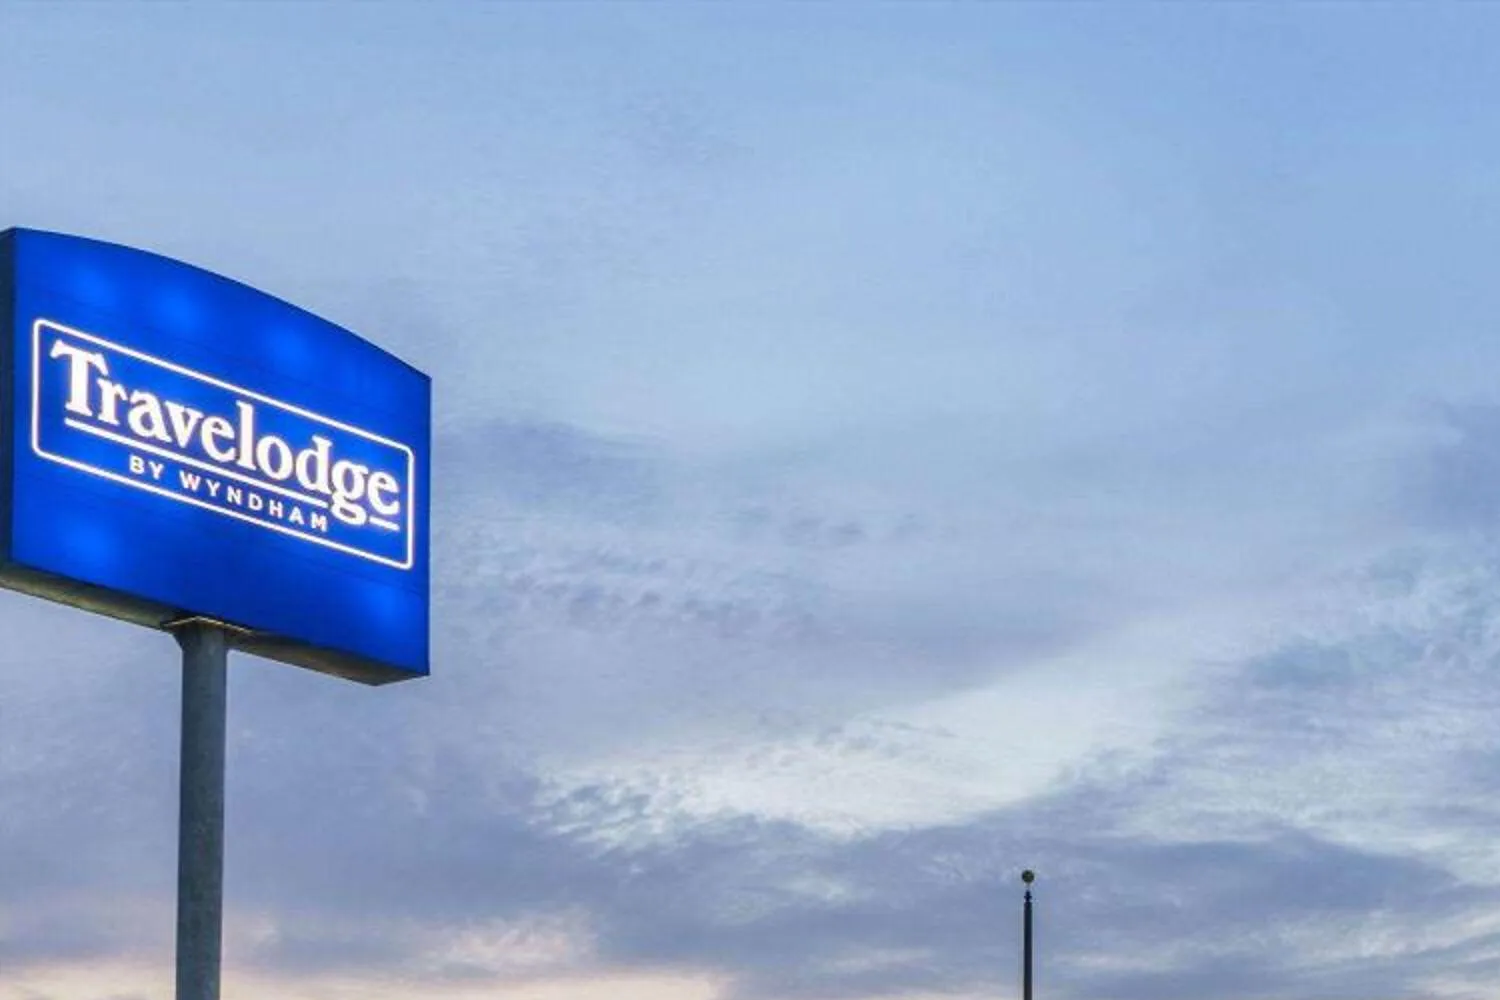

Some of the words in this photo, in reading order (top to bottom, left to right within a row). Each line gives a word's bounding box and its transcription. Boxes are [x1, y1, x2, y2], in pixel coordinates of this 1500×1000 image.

[50, 339, 401, 525] Travelodge
[129, 454, 165, 480] BY
[179, 470, 329, 532] WYNDHAM
